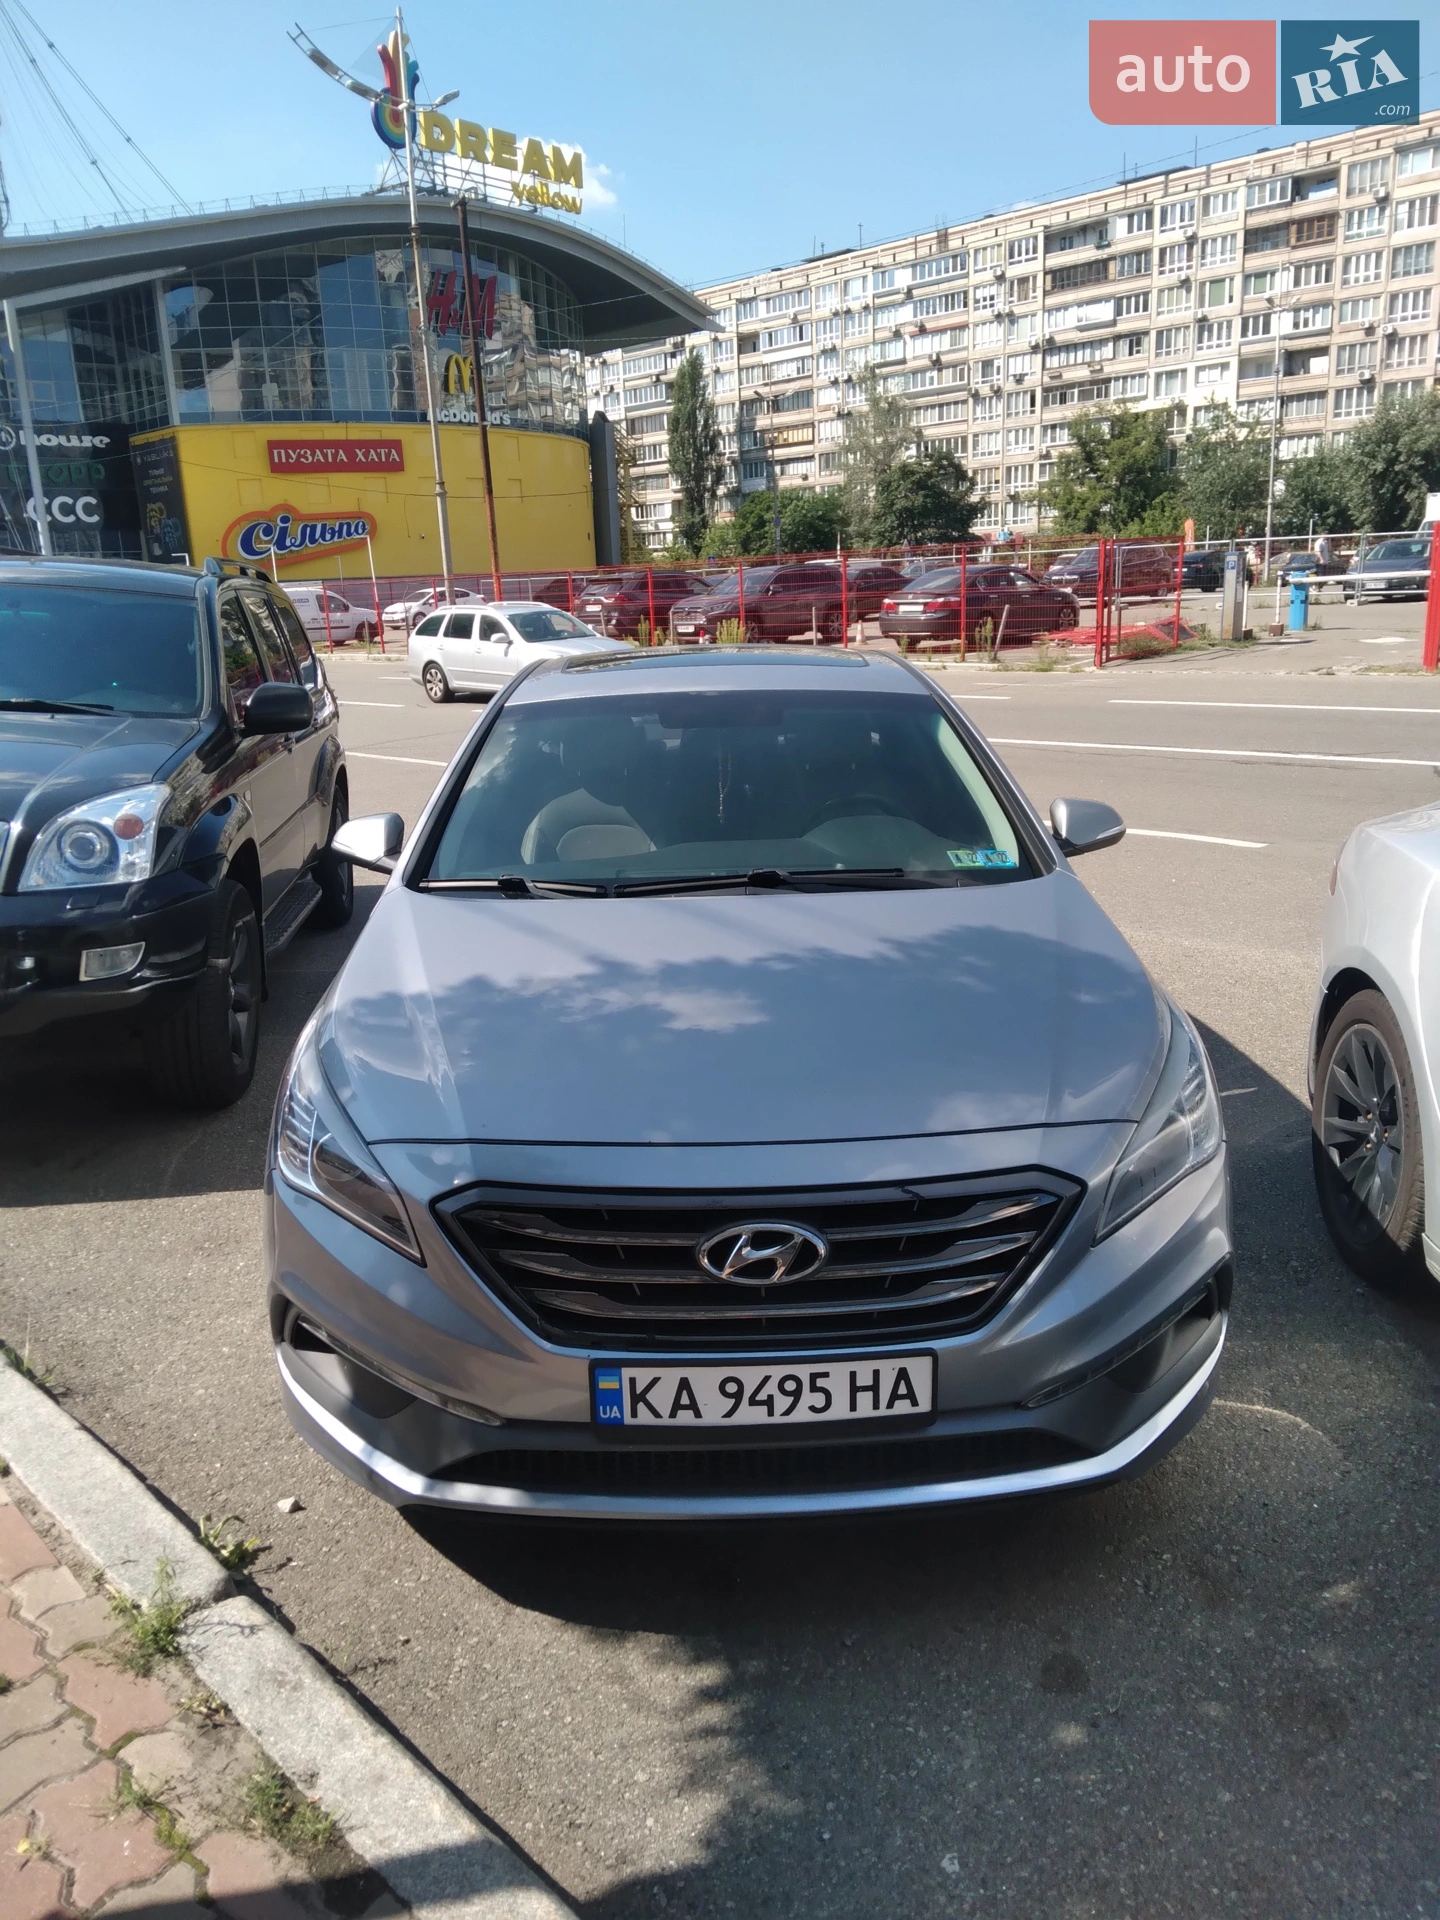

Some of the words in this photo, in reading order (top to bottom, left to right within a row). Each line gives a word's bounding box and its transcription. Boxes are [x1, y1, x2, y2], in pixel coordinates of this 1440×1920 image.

[418, 107, 584, 189] DREAM
[511, 181, 583, 214] yellow
[426, 268, 498, 341] H&M
[427, 407, 511, 425] McDonld's
[19, 429, 111, 448] house
[271, 448, 349, 463] ПУЗАТА
[354, 448, 401, 463] ХАТА
[7, 462, 106, 485] copp
[26, 495, 100, 523] CCC
[238, 514, 369, 559] Сільпо
[628, 1376, 703, 1419] KA
[718, 1371, 833, 1419] 9495
[849, 1366, 919, 1412] HA
[600, 1405, 621, 1419] UA
